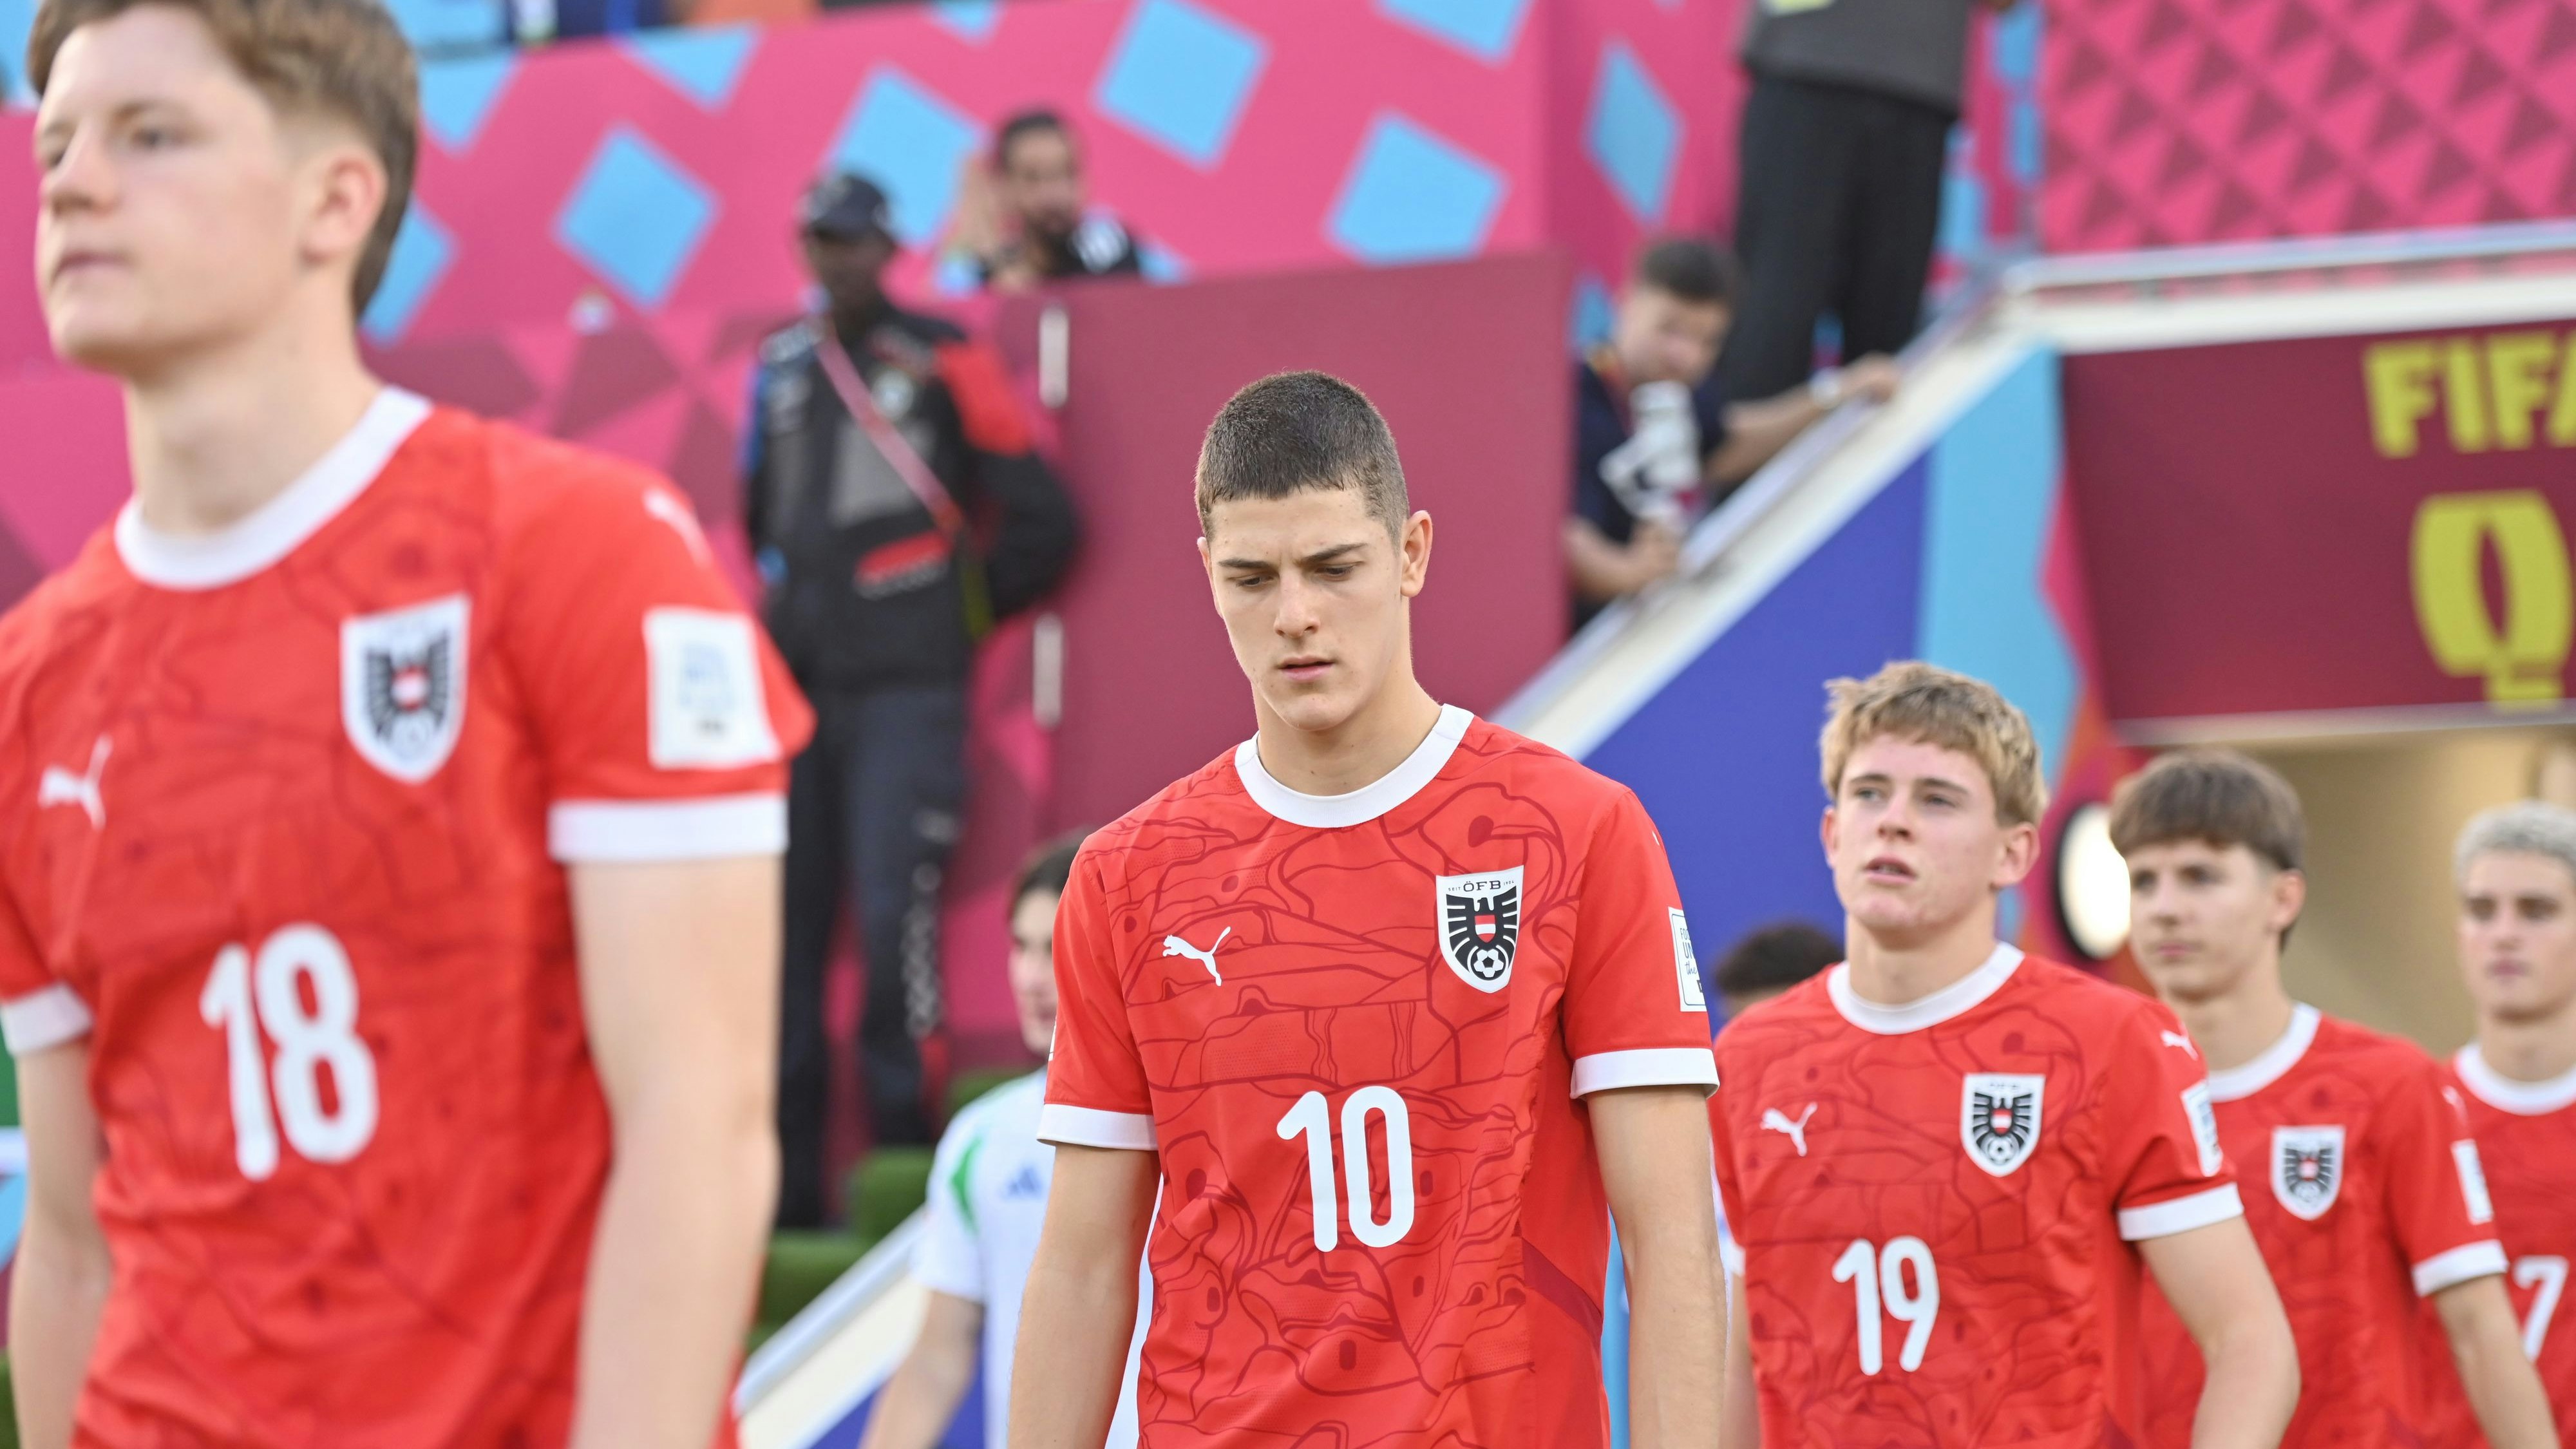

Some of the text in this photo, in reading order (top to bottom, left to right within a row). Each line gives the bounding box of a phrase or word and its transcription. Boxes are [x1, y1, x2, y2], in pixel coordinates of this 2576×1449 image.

[1463, 880, 1501, 893] ÖFB
[200, 921, 380, 1182] 18
[1276, 1086, 1415, 1252] 10
[1832, 1235, 1940, 1376] 19
